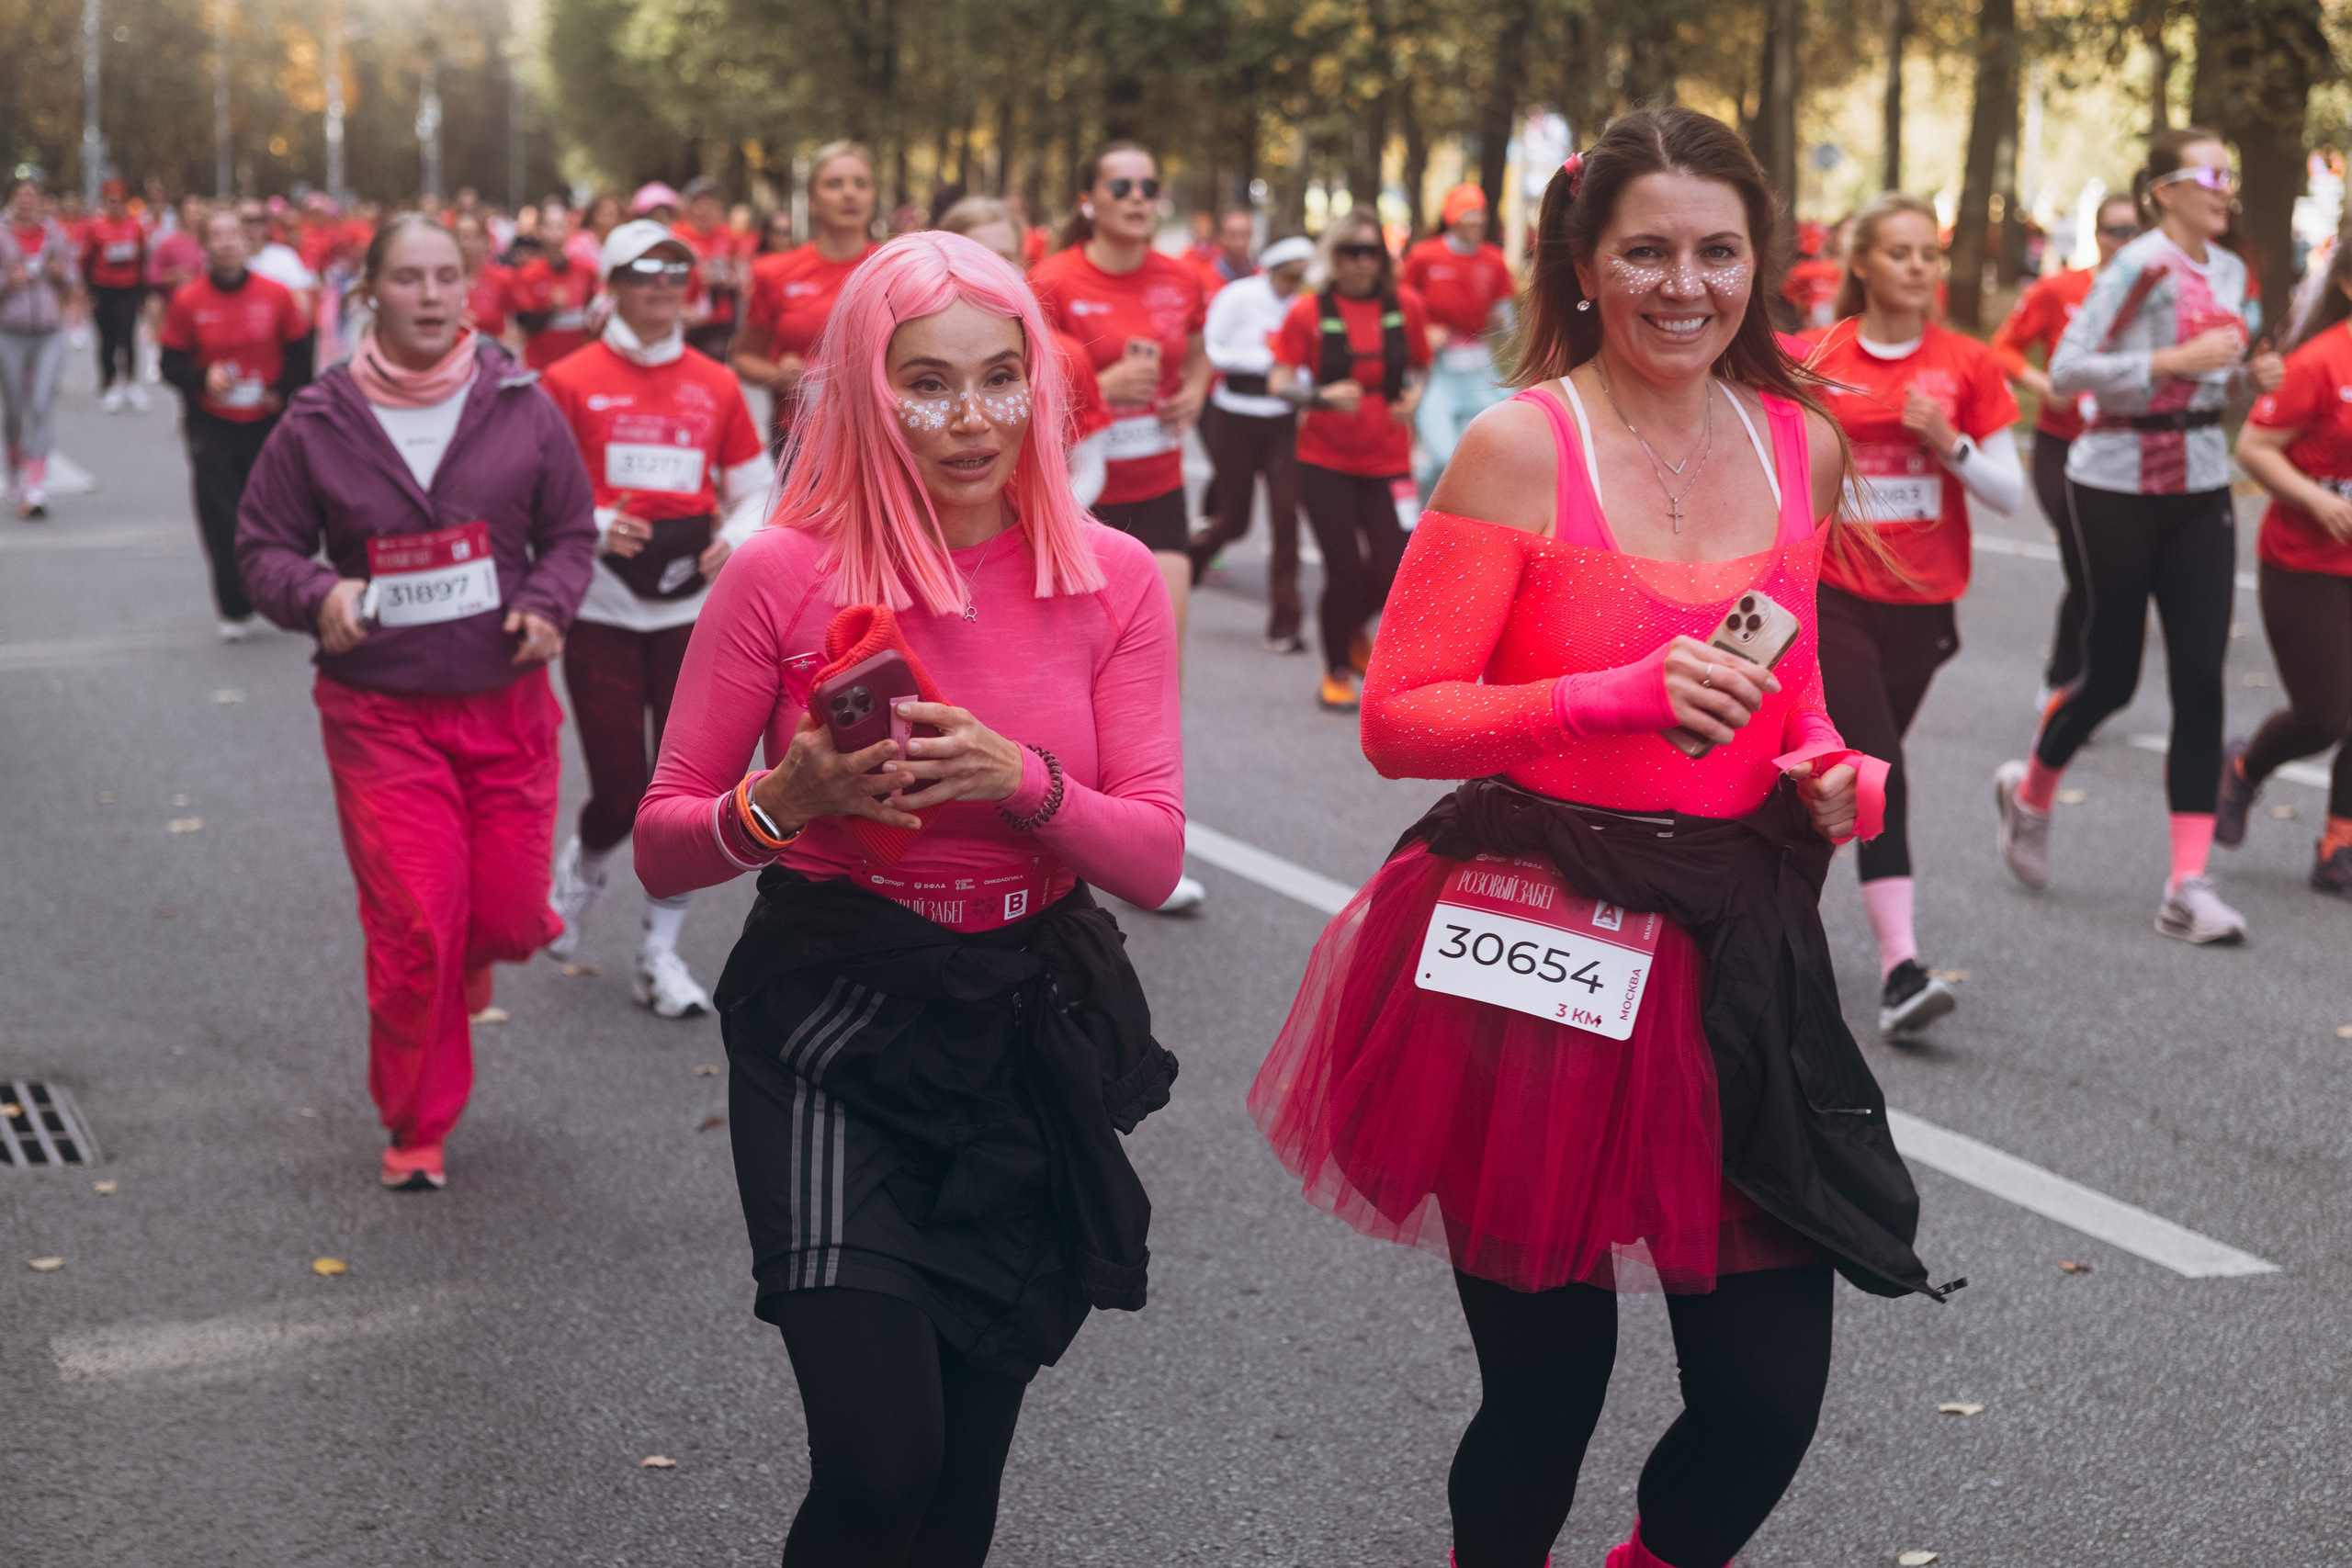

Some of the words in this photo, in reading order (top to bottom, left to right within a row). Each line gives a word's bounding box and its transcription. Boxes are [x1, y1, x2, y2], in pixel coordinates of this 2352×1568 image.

[387, 574, 468, 607] 31897
[984, 874, 1023, 885] ОНКОЛОГИКА
[1457, 870, 1519, 901] РОЗОВЫЙ
[1516, 879, 1558, 909] ЗАБЕГ
[928, 900, 967, 923] ЗАБЕГ
[1438, 923, 1604, 994] 30654
[1620, 968, 1642, 1021] МОСКВА
[1555, 1003, 1568, 1019] 3
[1572, 1008, 1601, 1028] КМ
